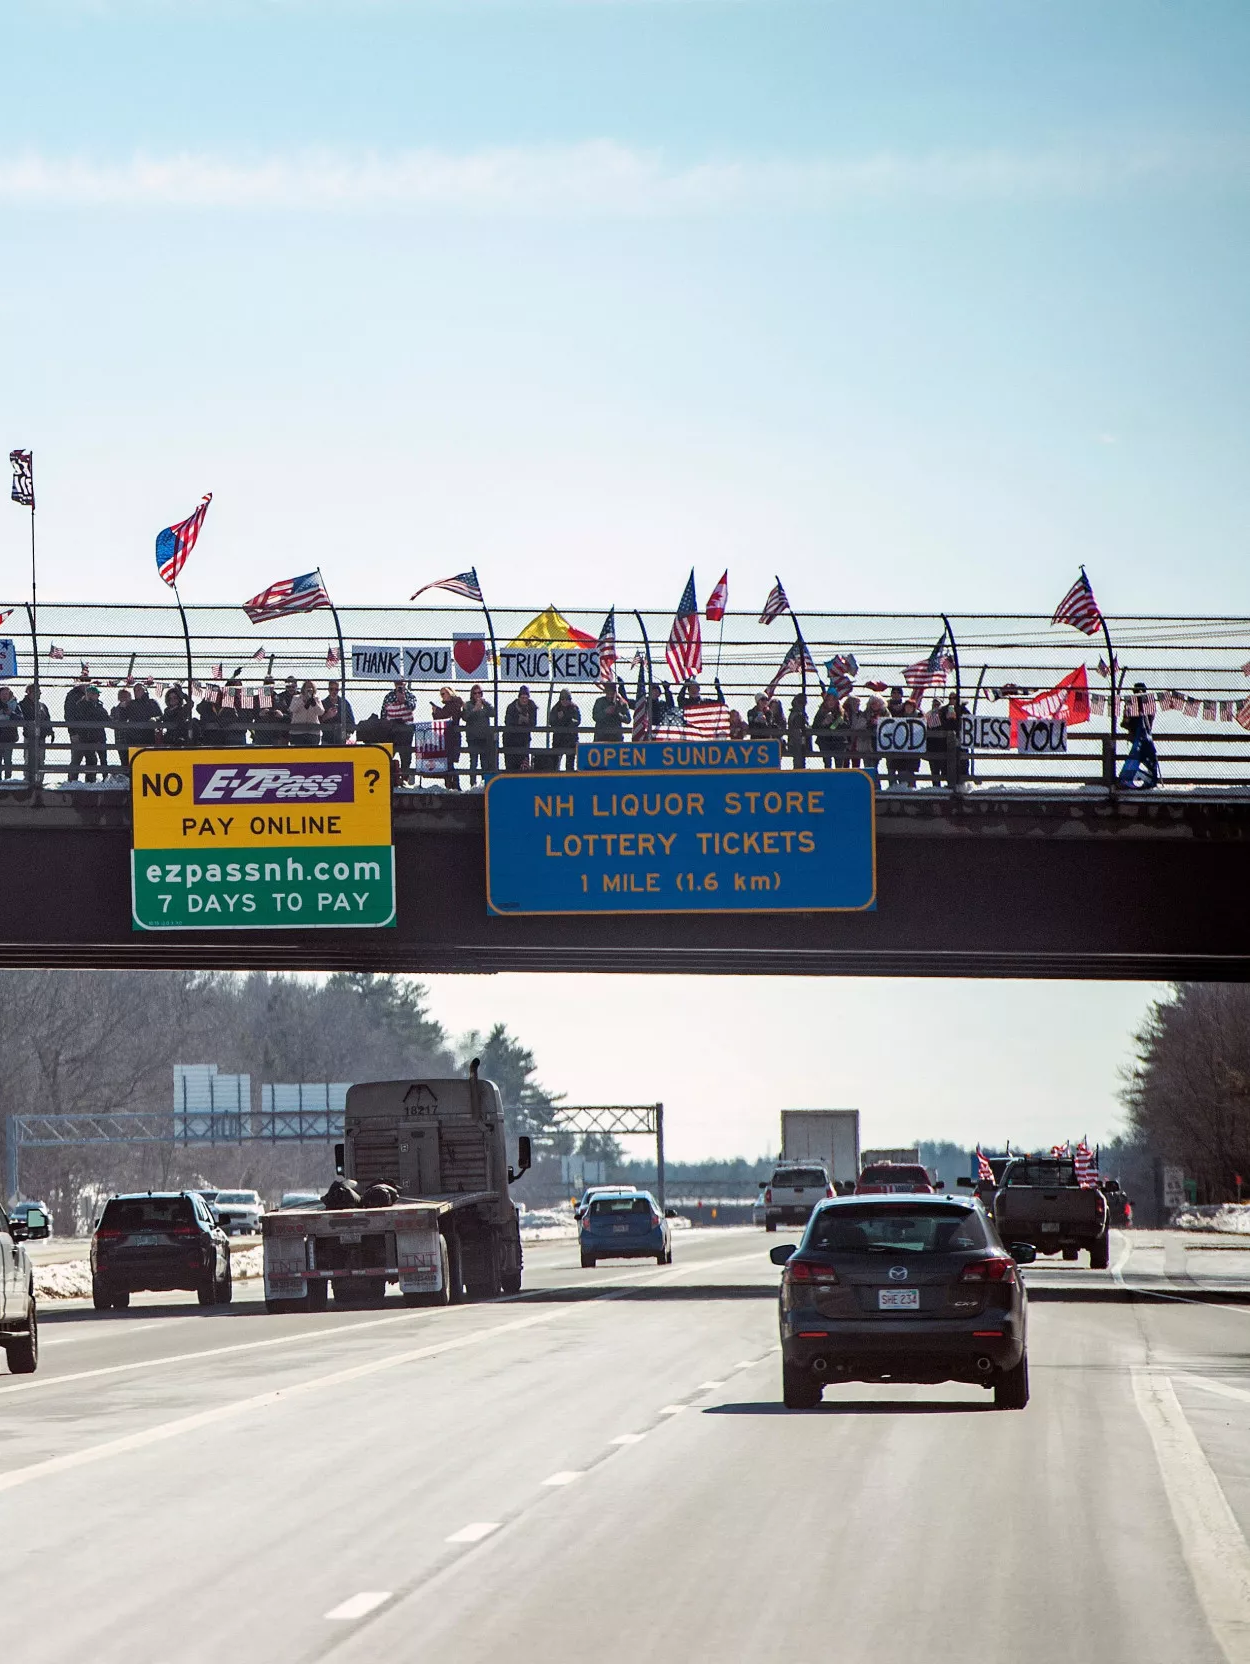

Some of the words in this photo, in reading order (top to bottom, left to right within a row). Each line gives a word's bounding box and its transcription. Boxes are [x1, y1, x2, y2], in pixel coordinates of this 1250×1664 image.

[352, 652, 401, 674] THANK
[405, 650, 448, 675] YOU
[500, 652, 601, 678] TRUCKERS
[878, 719, 926, 750] GOD
[961, 718, 1011, 749] BLESS
[1020, 721, 1067, 752] YOU
[588, 748, 646, 767] OPEN
[662, 745, 770, 766] SUNDAYS
[142, 772, 183, 797] NO
[364, 769, 380, 794] ?
[534, 795, 574, 817] NH
[593, 793, 705, 817] LIQUOR
[725, 791, 825, 815] STORE
[182, 817, 235, 836] PAY
[250, 816, 342, 835] ONLINE
[546, 833, 676, 856] LOTTERY
[697, 831, 816, 855] TICKETS
[146, 857, 381, 888] ezpassnh.com
[581, 874, 588, 892] 1
[603, 873, 661, 892] MILE
[676, 872, 719, 892] (1.6
[734, 871, 782, 892] km)
[158, 894, 172, 913] 7
[188, 893, 257, 913] DAYS
[272, 893, 303, 912] TO
[318, 892, 370, 912] PAY
[404, 1105, 438, 1115] 18217
[402, 1252, 437, 1267] TNT
[882, 1295, 898, 1305] SHE
[901, 1295, 918, 1305] 234
